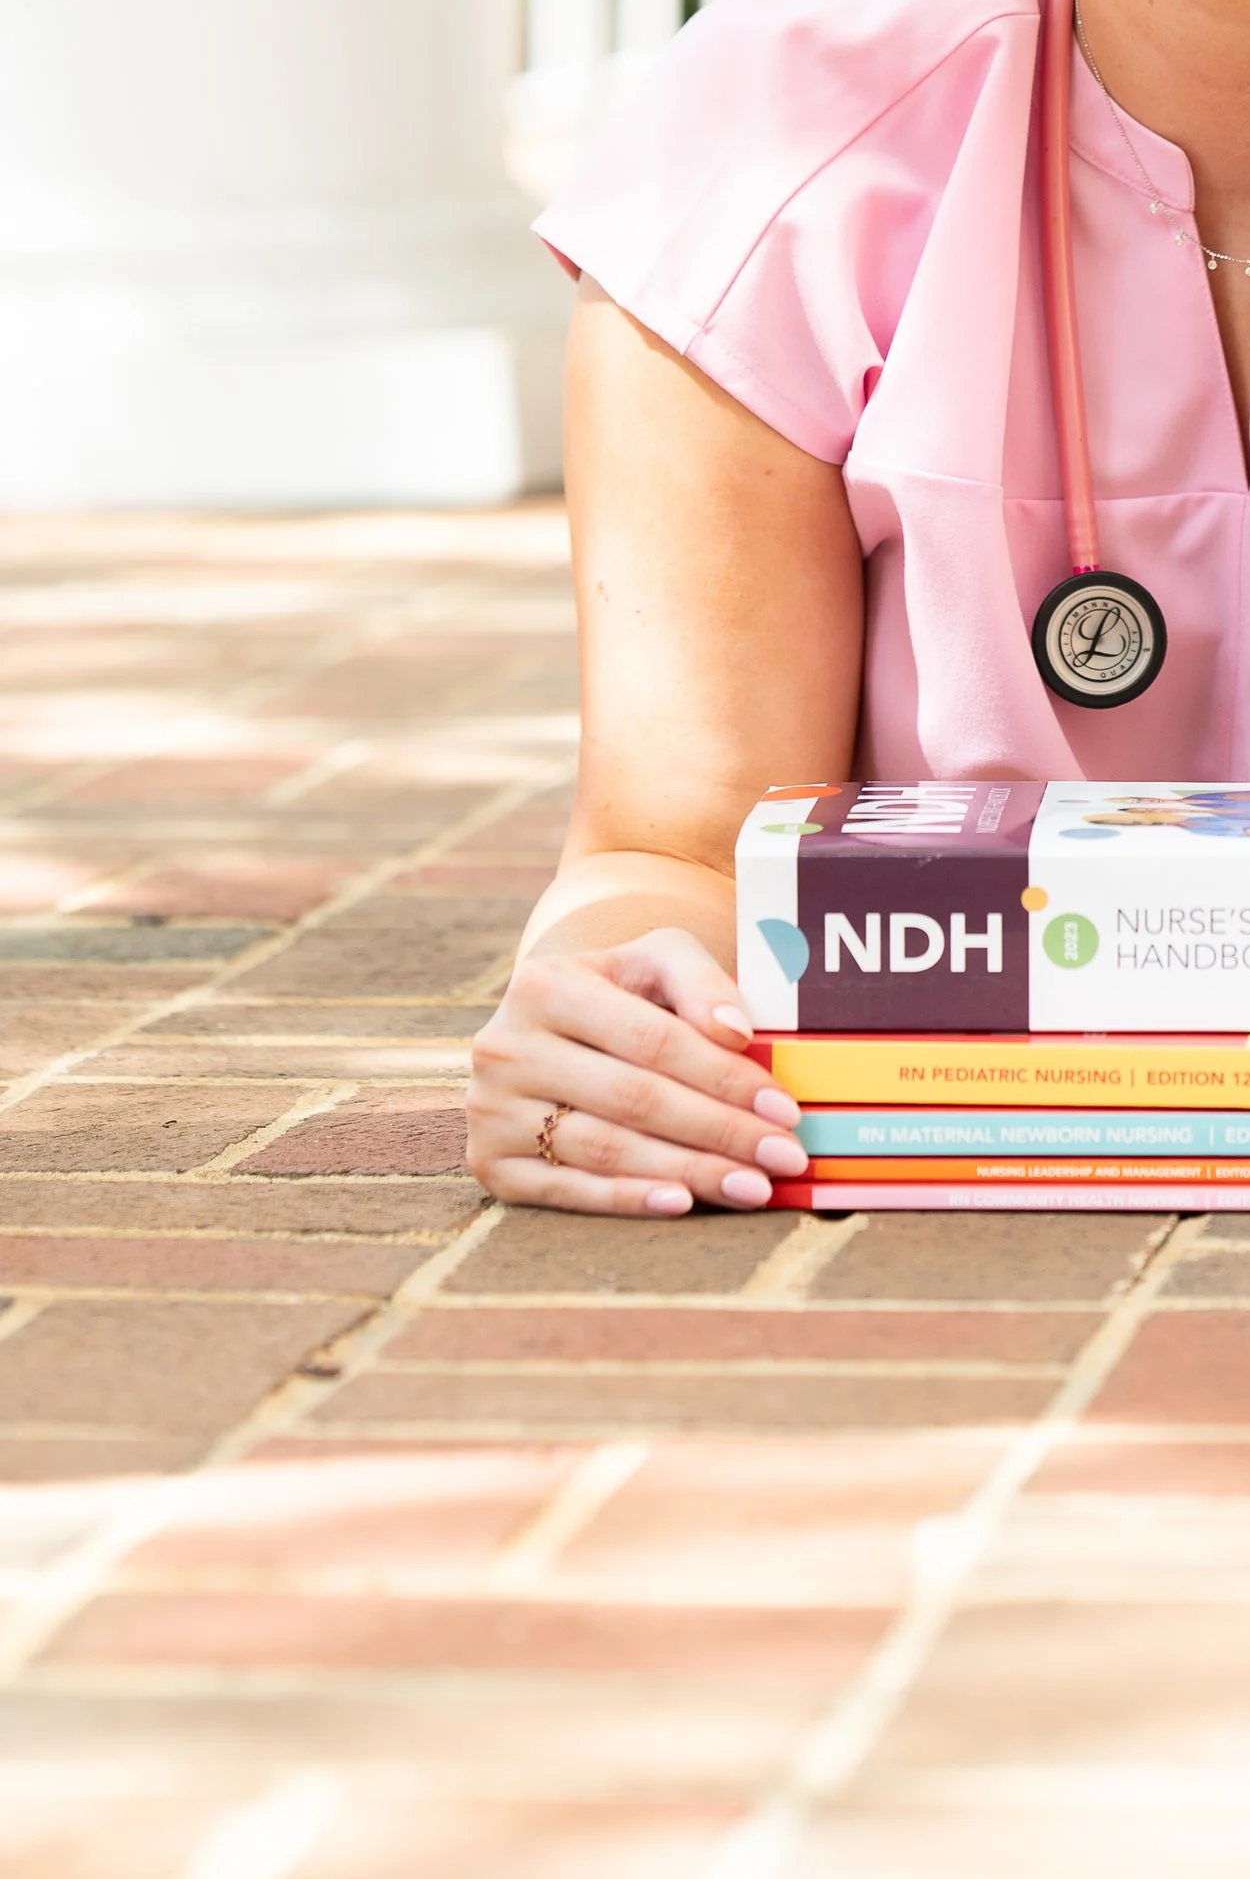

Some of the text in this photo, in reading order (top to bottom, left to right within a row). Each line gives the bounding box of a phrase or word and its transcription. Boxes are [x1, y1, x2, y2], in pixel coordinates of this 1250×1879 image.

[1064, 601, 1109, 658] LITTMANN
[1100, 629, 1139, 679] QUALITY
[841, 786, 976, 834] NDH
[824, 912, 1003, 973] NDH
[1064, 921, 1079, 962] 2023
[899, 1066, 925, 1082] RN
[932, 1067, 1028, 1083] PEDIATRIC
[1035, 1068, 1122, 1086] NURSING
[1146, 1071, 1225, 1086] EDITION
[858, 1126, 886, 1144] RN
[891, 1126, 996, 1145] MATERNAL
[1000, 1126, 1101, 1145] NEWBORN
[1209, 1124, 1214, 1146] |
[976, 1166, 1026, 1178] NURSING
[1028, 1166, 1093, 1178] LEADERSHIP
[1095, 1166, 1120, 1178] AND
